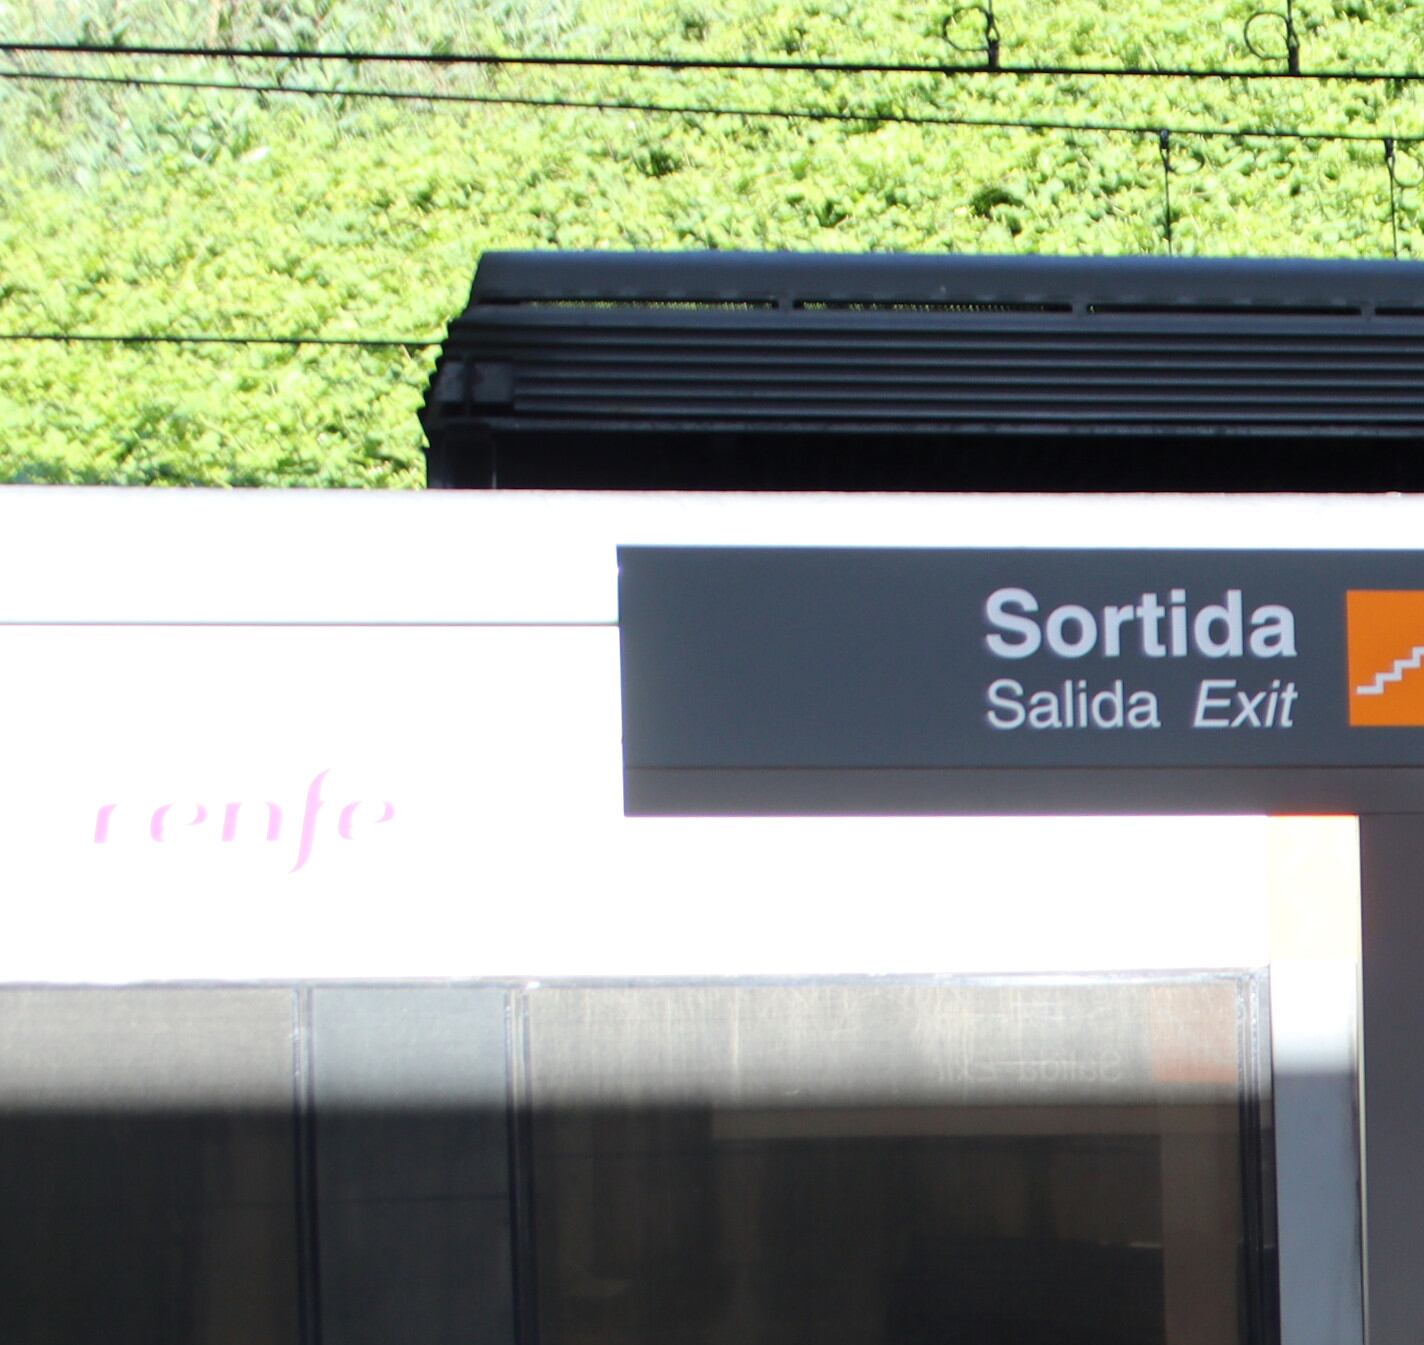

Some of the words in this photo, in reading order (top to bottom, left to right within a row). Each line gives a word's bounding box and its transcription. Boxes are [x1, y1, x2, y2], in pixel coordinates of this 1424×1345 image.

[984, 587, 1298, 658] Sortida
[986, 678, 1162, 731] Salida
[1192, 680, 1299, 730] Exit
[93, 768, 396, 874] renfe
